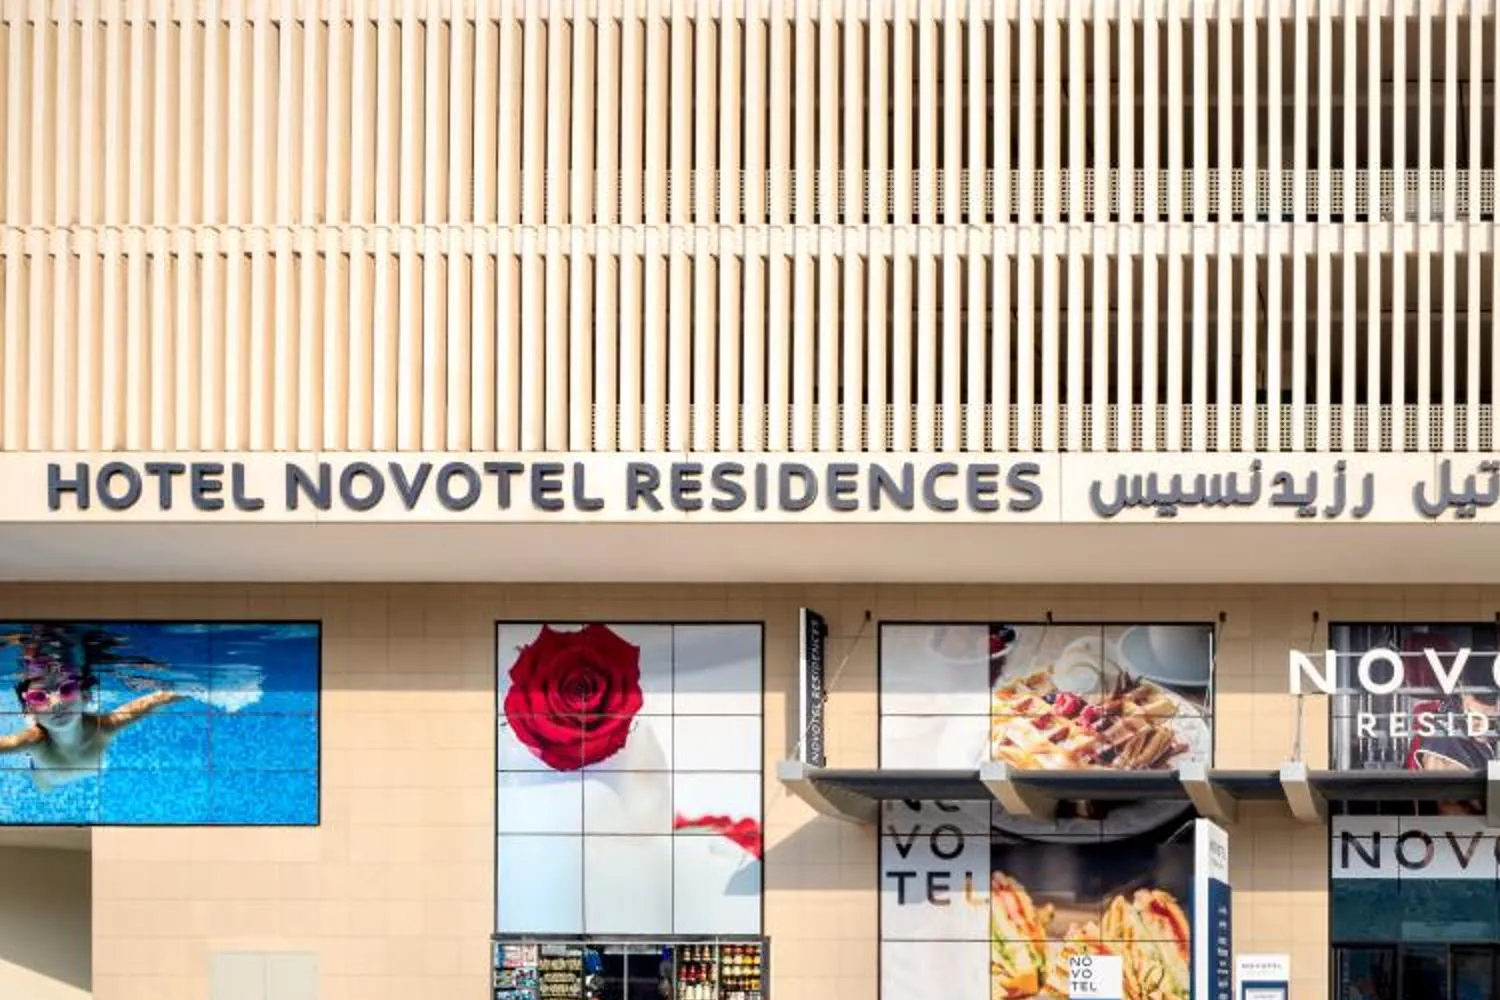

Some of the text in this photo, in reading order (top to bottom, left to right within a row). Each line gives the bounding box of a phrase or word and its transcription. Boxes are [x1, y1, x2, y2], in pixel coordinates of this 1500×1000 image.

[47, 461, 1043, 512] HOTEL NOVOTEL RESIDENCES
[1089, 458, 1376, 519] رزيدنسيس
[811, 702, 821, 762] NOVOTEL
[887, 824, 964, 859] VO
[886, 871, 990, 905] TEL
[1070, 956, 1093, 967] NO
[1071, 969, 1093, 979] VO
[1071, 981, 1097, 991] TEL
